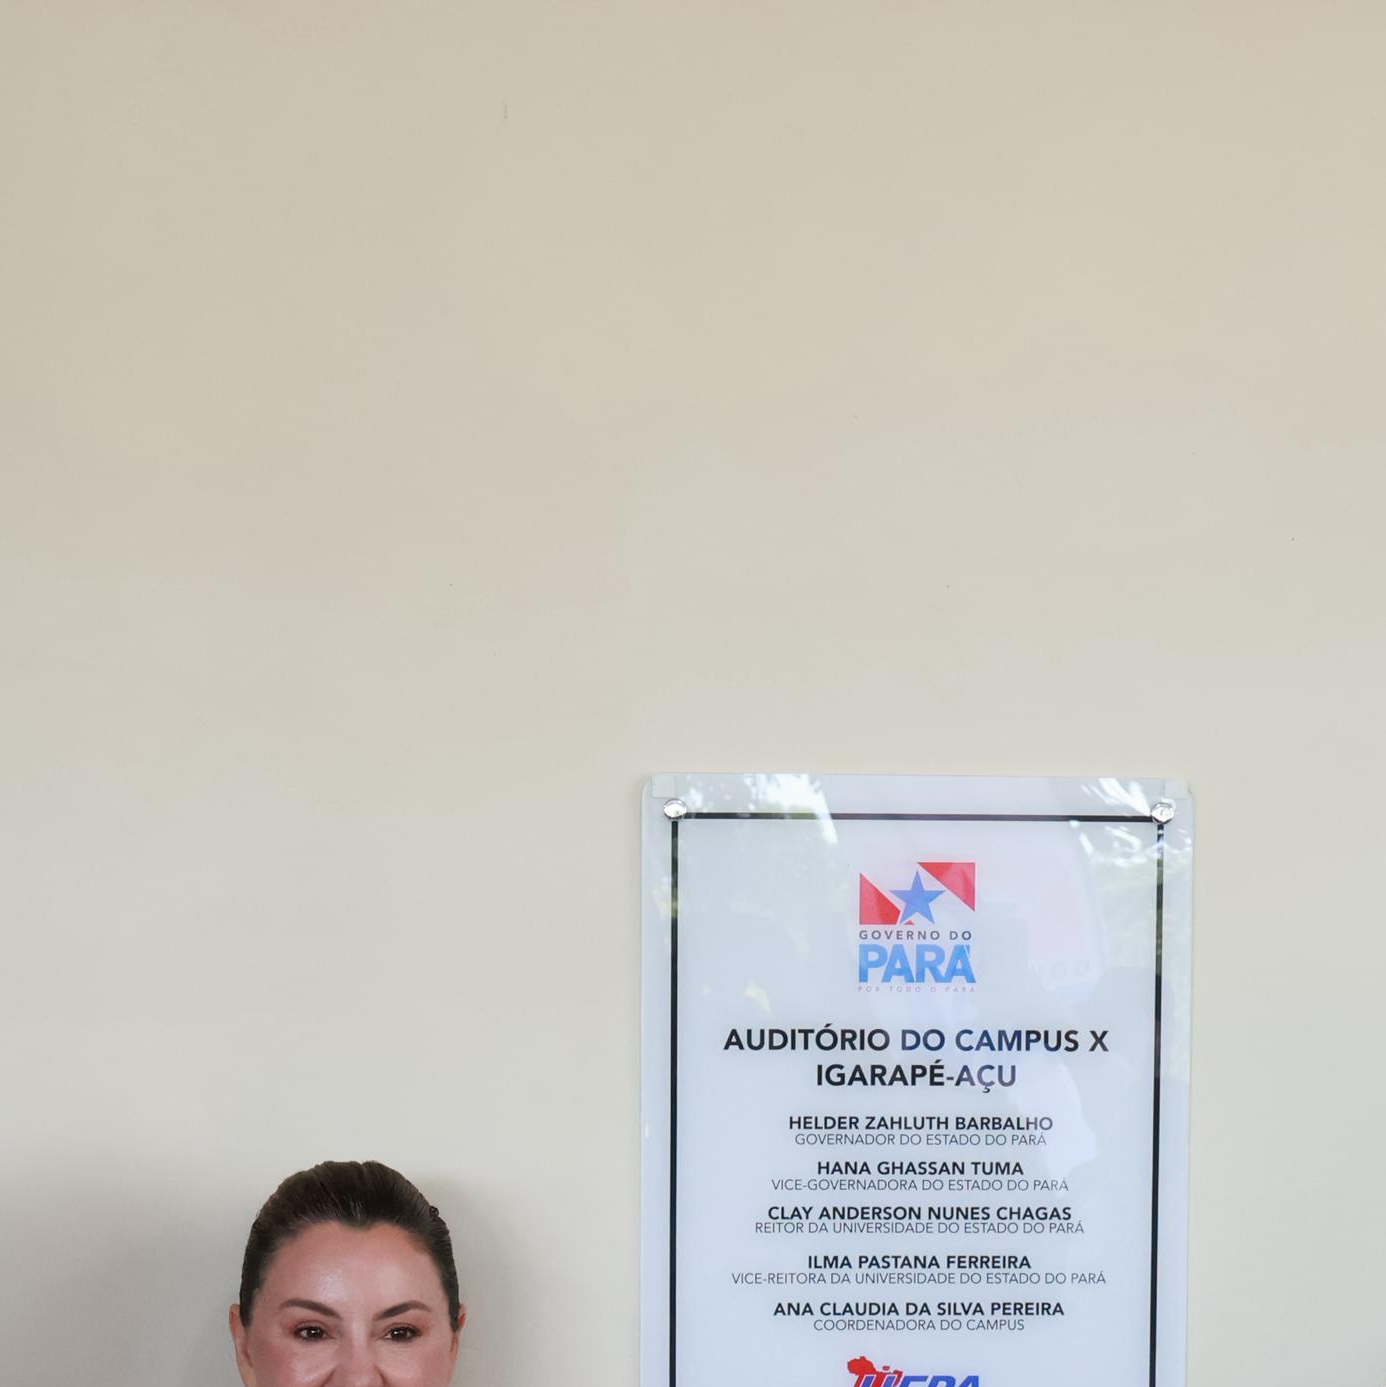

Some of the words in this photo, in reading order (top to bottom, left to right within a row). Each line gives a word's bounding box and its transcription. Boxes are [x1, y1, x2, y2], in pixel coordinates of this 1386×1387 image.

[859, 930, 941, 941] GOVERNO
[949, 930, 972, 941] DO
[858, 943, 976, 983] PARÁ
[723, 1023, 891, 1052] AUDITÓRIO
[900, 1029, 945, 1052] DO
[955, 1029, 1079, 1052] CAMPUS
[1089, 1029, 1110, 1052] X
[816, 1059, 1017, 1093] IGARAPÉ-AÇU
[789, 1116, 860, 1130] HELDER
[865, 1116, 949, 1130] ZAHLUTH
[955, 1116, 1053, 1130] BARBALHO
[795, 1133, 895, 1145] GOVERNADOR
[900, 1133, 921, 1145] DO
[926, 1133, 981, 1145] ESTADO
[985, 1133, 1007, 1145] DO
[1012, 1132, 1047, 1145] PARÁ
[817, 1161, 871, 1175] HANA
[877, 1161, 965, 1175] GHASSAN
[971, 1161, 1024, 1175] TUMA
[771, 1179, 917, 1191] VICE-GOVERNADORA
[922, 1179, 944, 1191] DO
[948, 1179, 1003, 1191] ESTADO
[1007, 1179, 1029, 1191] DO
[1033, 1177, 1069, 1191] PARÁ
[768, 1206, 813, 1220] CLAY
[818, 1206, 921, 1220] ANDERSON
[928, 1206, 990, 1220] NUNES
[996, 1206, 1072, 1220] CHAGAS
[755, 1222, 804, 1234] REITOR
[808, 1222, 829, 1234] DA
[833, 1222, 933, 1234] UNIVERSIDADE
[938, 1222, 960, 1234] DO
[964, 1222, 1018, 1234] ESTADO
[1023, 1222, 1045, 1234] DO
[1049, 1220, 1085, 1234] PARÁ
[808, 1255, 852, 1269] ILMA
[858, 1255, 940, 1269] PASTANA
[946, 1255, 1031, 1269] FERREIRA
[731, 1272, 827, 1284] VICE-REITORA
[830, 1272, 851, 1284] DA
[855, 1272, 956, 1284] UNIVERSIDADE
[960, 1272, 982, 1284] DO
[986, 1272, 1041, 1284] ESTADO
[1045, 1272, 1067, 1284] DO
[1071, 1270, 1106, 1284] PARÁ
[773, 1302, 814, 1316] ANA
[819, 1302, 899, 1316] CLAUDIA
[906, 1302, 931, 1316] DA
[937, 1302, 985, 1316] SILVA
[991, 1302, 1065, 1316] PEREIRA
[813, 1319, 936, 1331] COORDENADORA
[940, 1319, 962, 1331] DO
[966, 1319, 1025, 1331] CAMPUS
